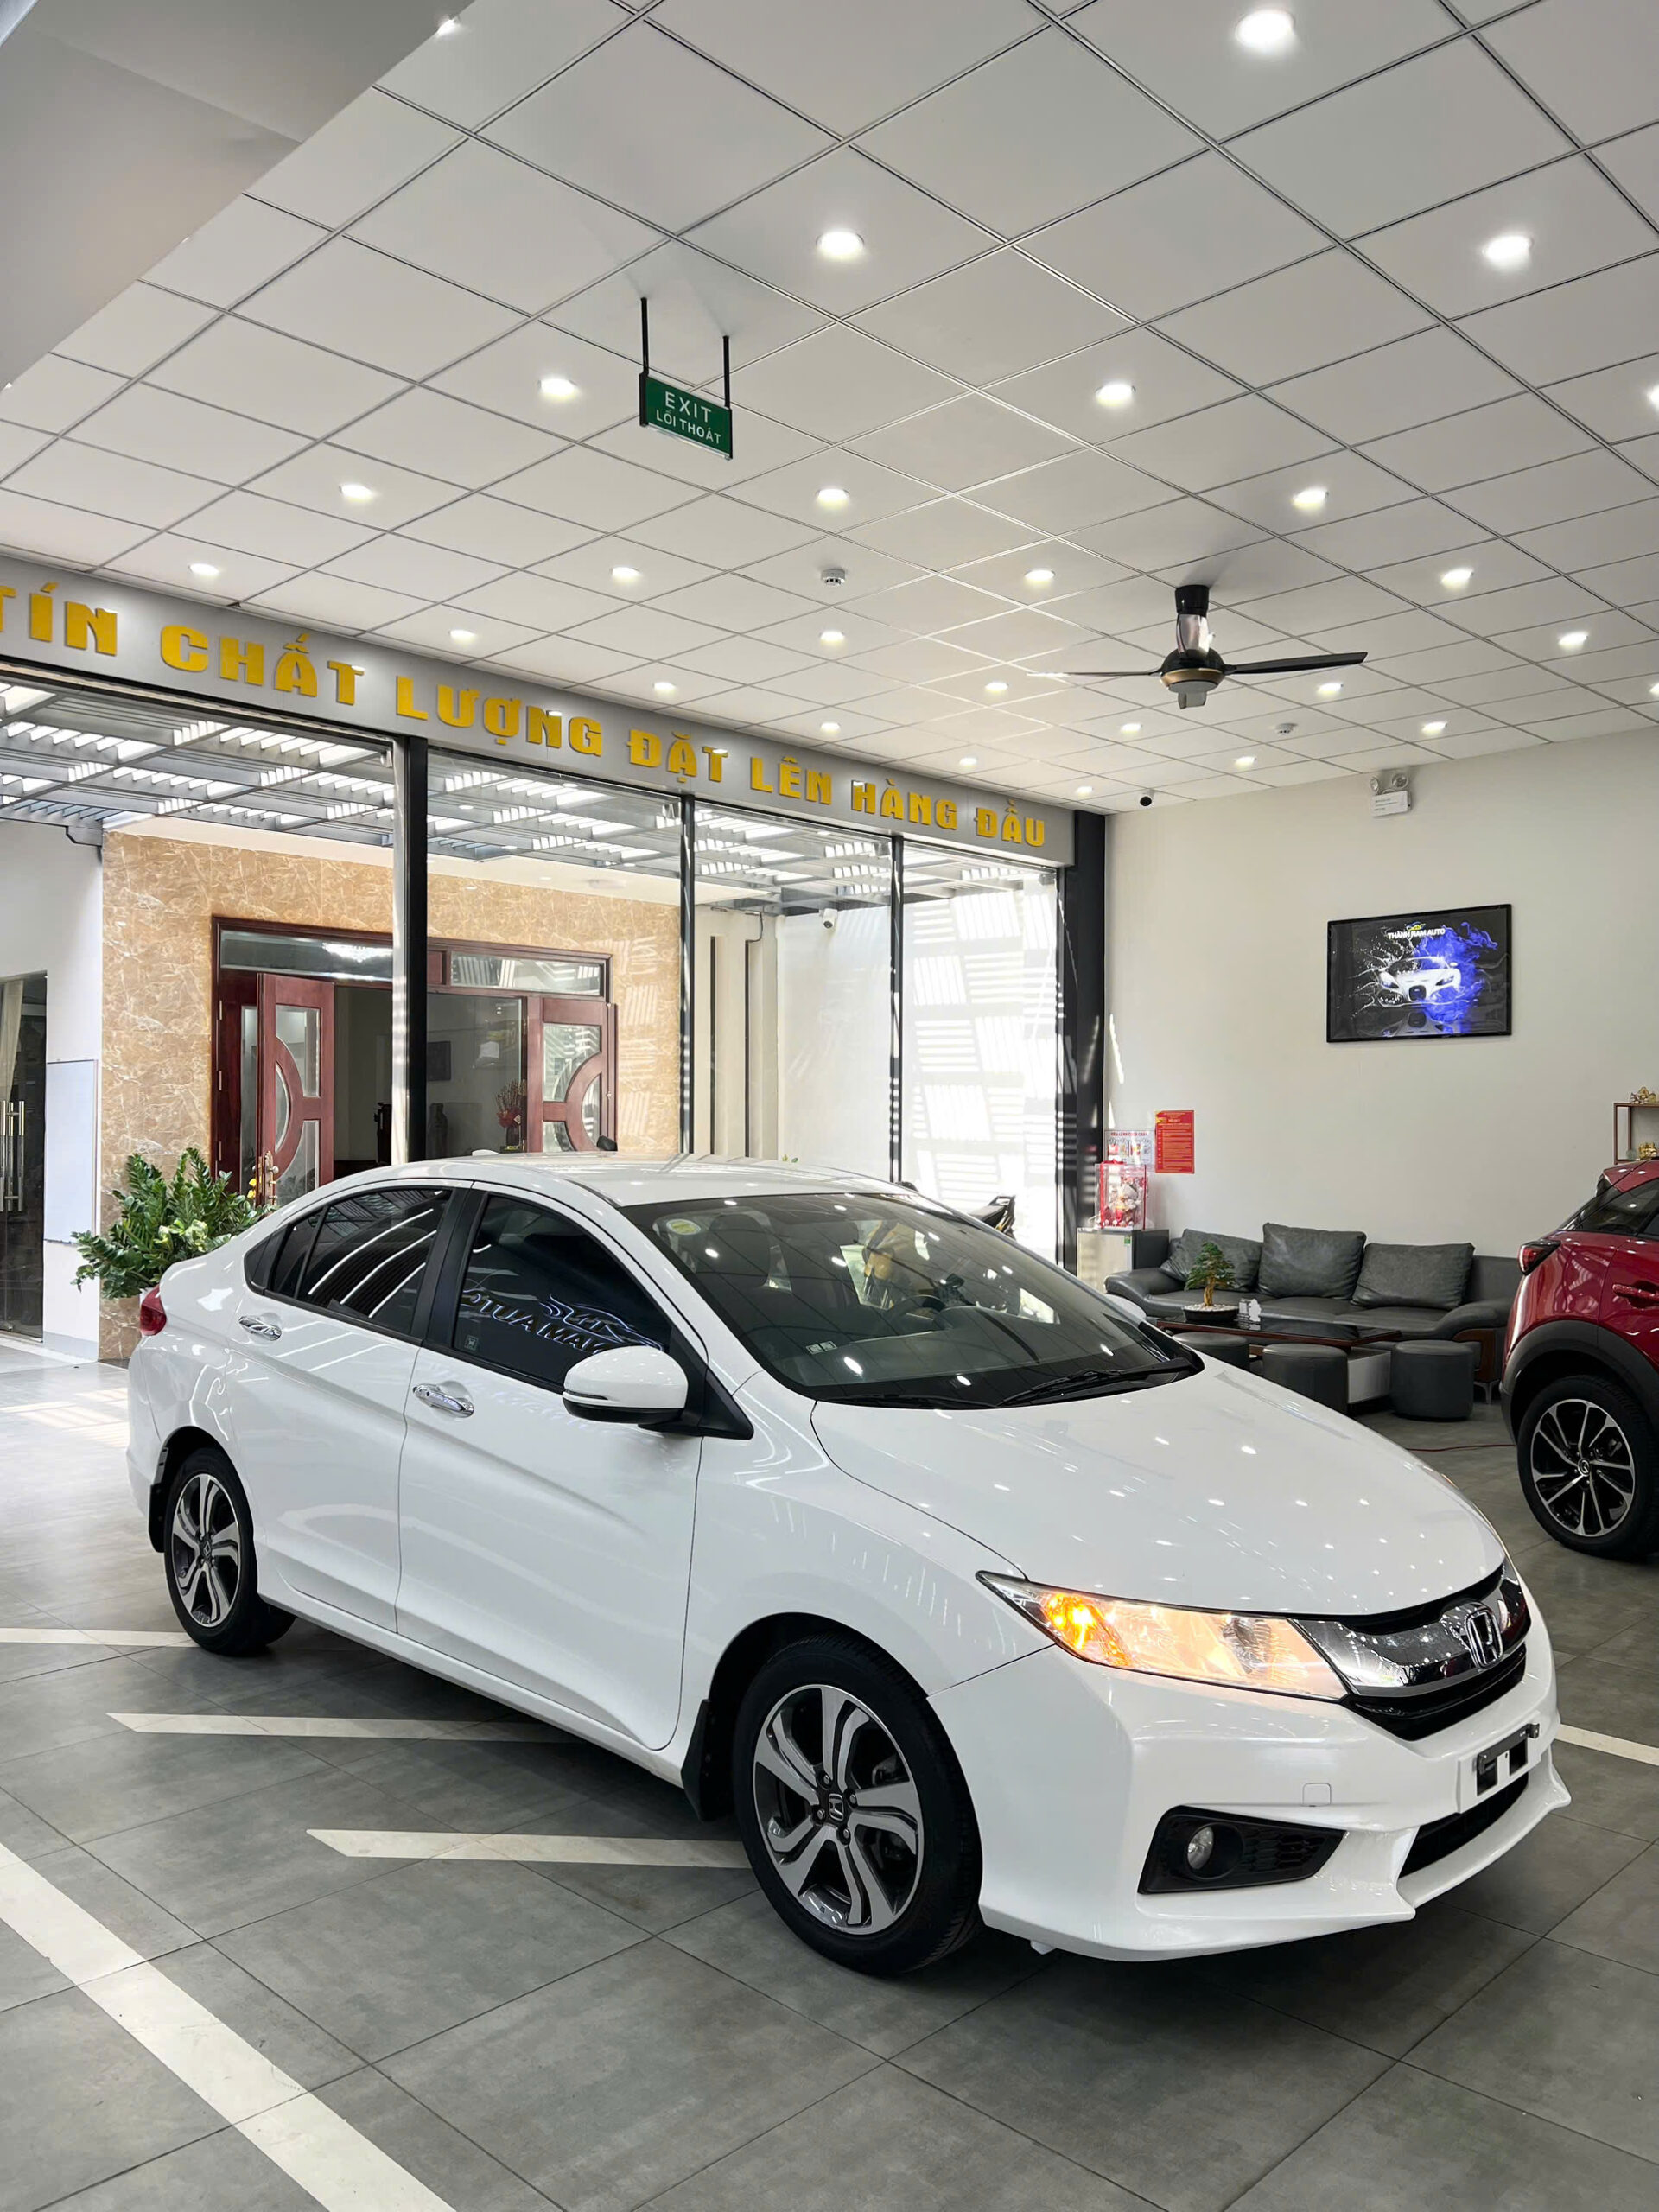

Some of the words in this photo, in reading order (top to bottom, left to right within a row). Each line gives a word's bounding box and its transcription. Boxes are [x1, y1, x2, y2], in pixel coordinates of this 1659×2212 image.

[656, 409, 677, 427] LỐI
[664, 391, 712, 423] EXIT
[160, 625, 365, 705] CHẤT
[397, 676, 603, 757] LƯỢNG
[627, 729, 728, 783] ĐẶT
[750, 756, 833, 805] LÊN
[851, 779, 958, 830] HÀNG
[974, 799, 1045, 848] ĐẦU
